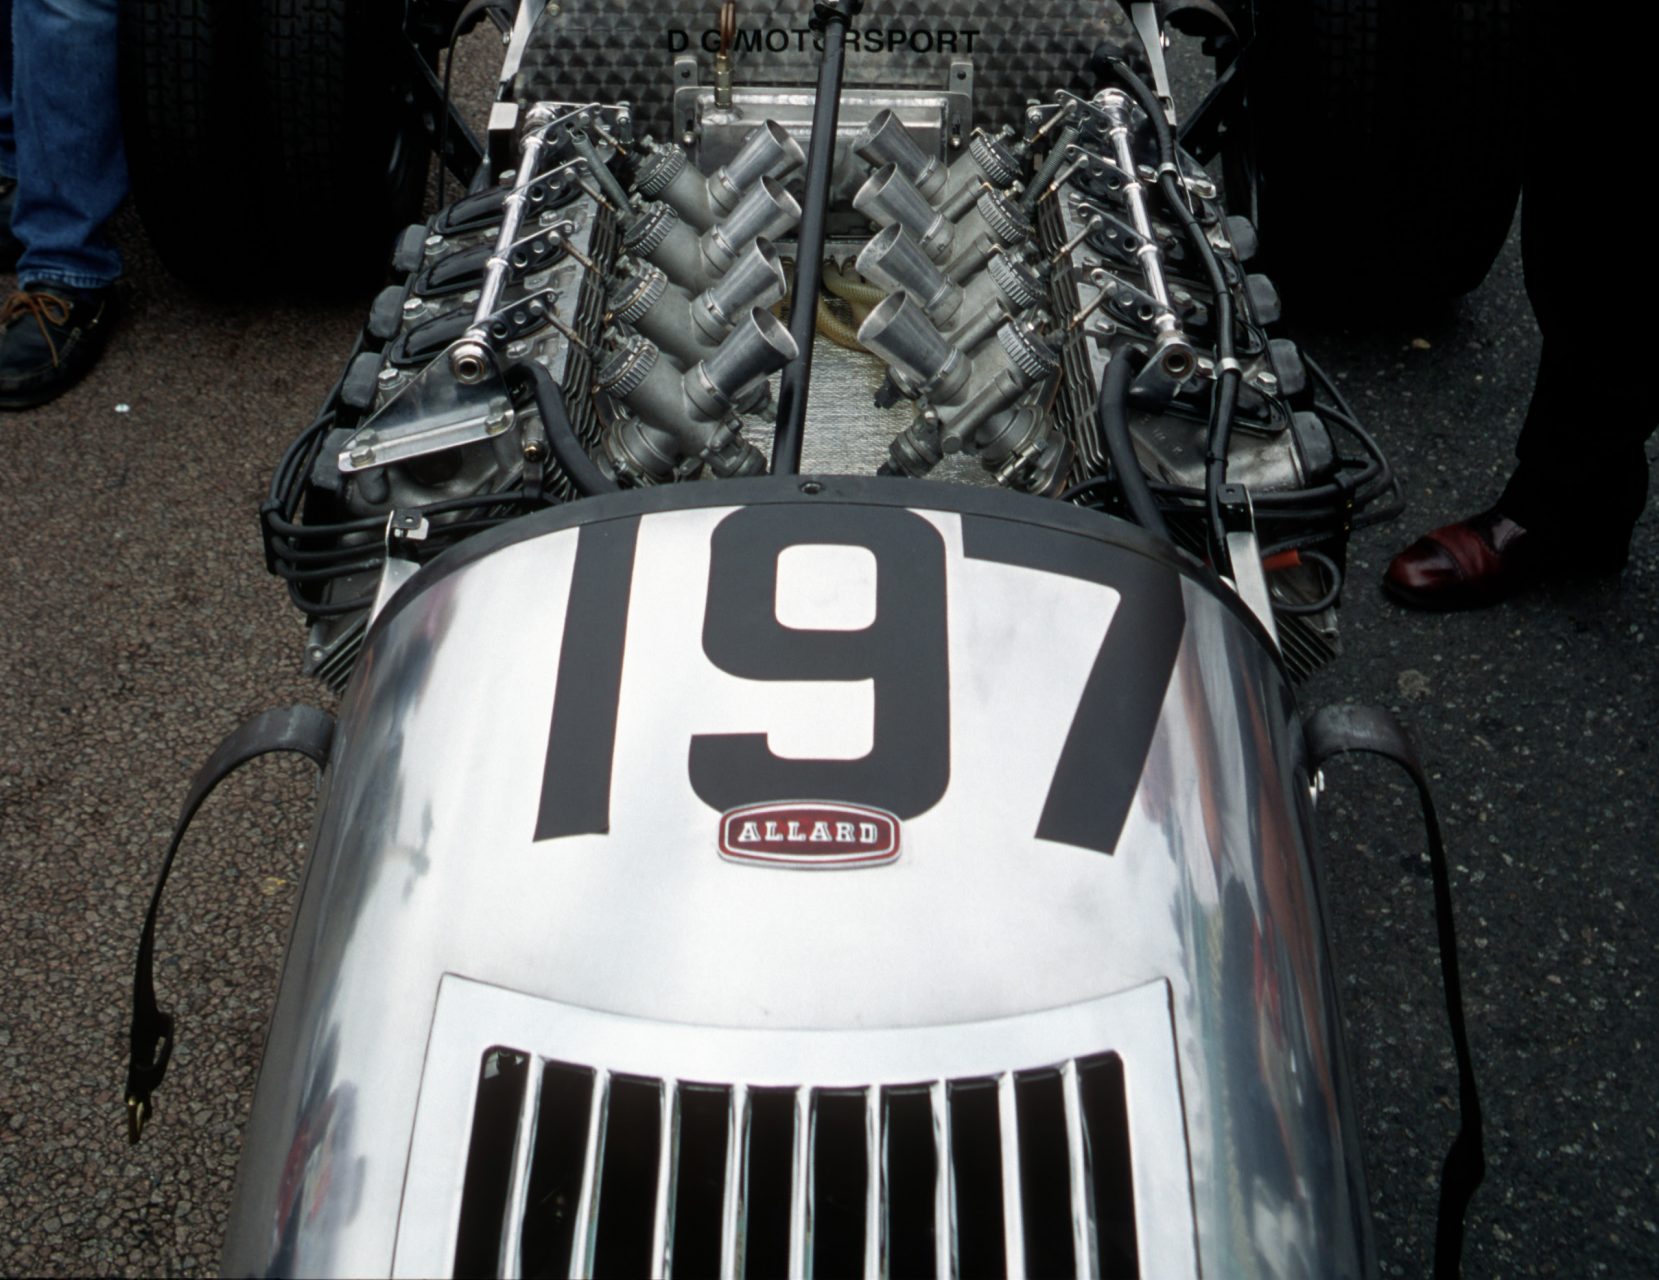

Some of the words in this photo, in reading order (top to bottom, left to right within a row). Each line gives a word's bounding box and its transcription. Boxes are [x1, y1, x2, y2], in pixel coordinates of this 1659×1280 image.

[667, 29, 690, 53] D
[733, 28, 981, 54] MOTRSPORT
[533, 503, 1186, 856] 197
[738, 822, 878, 843] ALLARD
